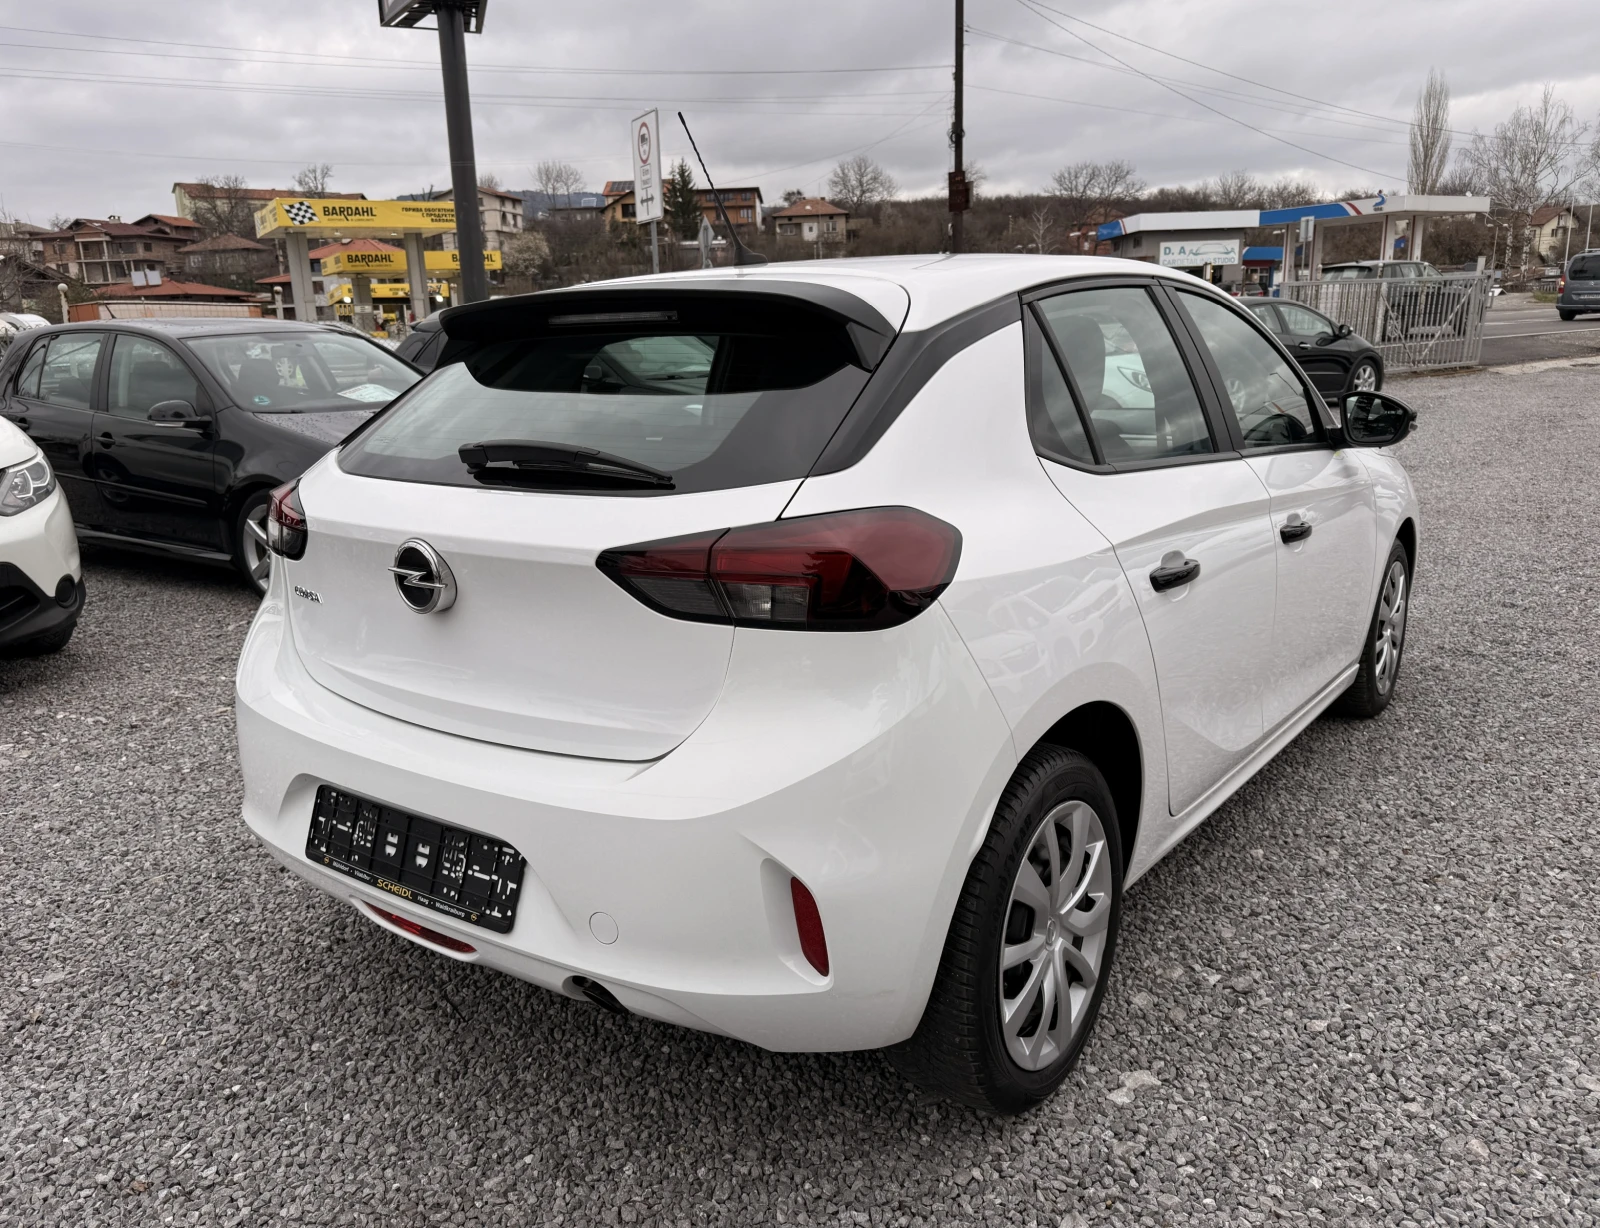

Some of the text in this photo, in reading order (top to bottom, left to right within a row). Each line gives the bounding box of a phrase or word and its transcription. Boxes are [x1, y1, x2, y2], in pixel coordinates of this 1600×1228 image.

[323, 206, 377, 221] BARDAHL
[347, 254, 394, 267] BARDAHL
[377, 879, 412, 899] SCHEIDL
[417, 895, 430, 905] Haag
[435, 901, 466, 917] Waldkraiburg
